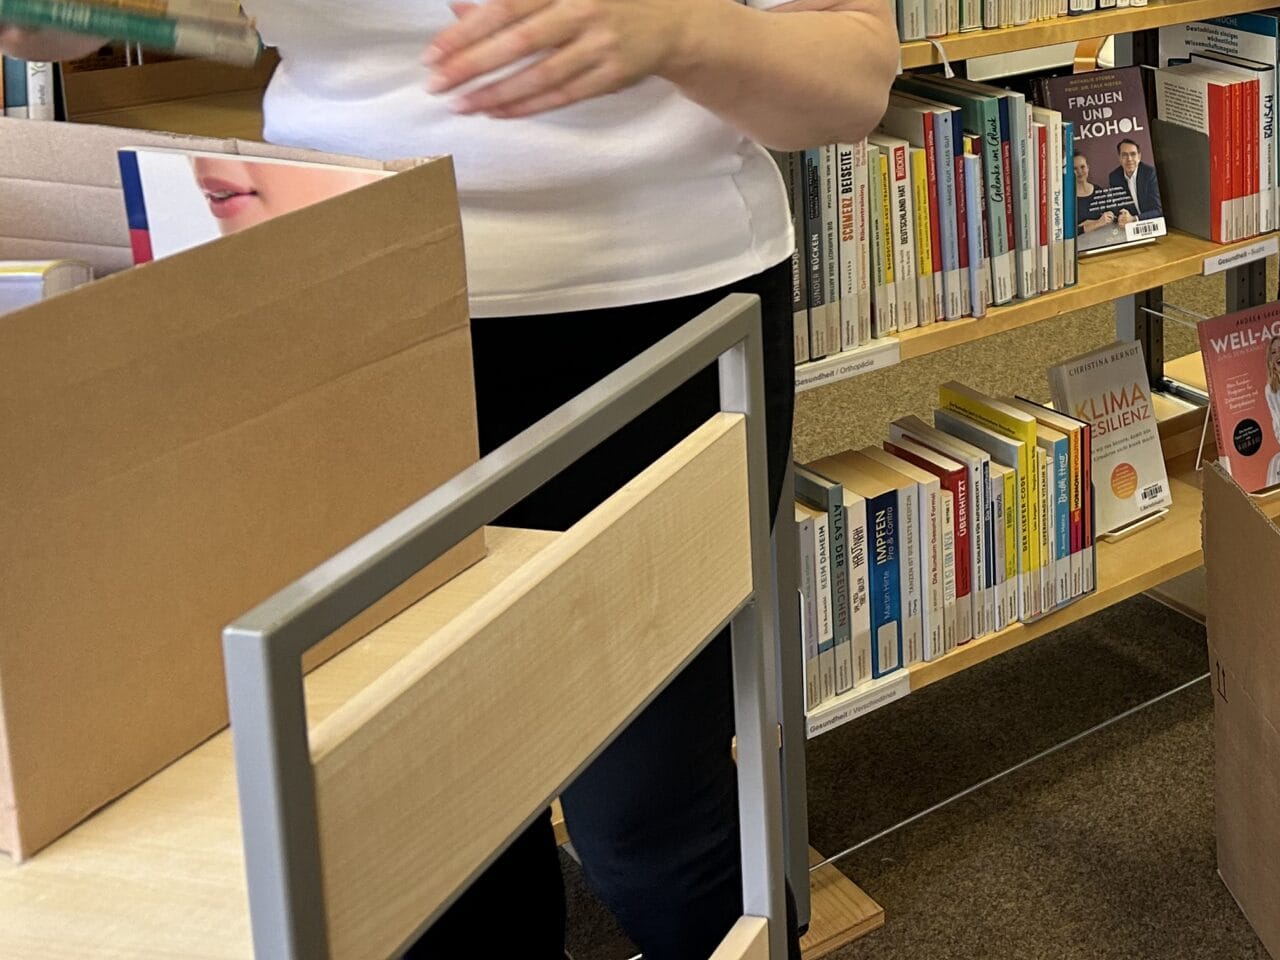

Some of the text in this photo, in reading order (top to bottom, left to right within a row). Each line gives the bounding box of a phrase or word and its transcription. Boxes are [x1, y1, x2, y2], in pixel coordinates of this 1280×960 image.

[1185, 39, 1238, 55] Wissenschaftsmagazin
[1186, 25, 1220, 37] Deutschlands
[1068, 91, 1123, 110] FRAUEN
[1082, 107, 1113, 122] UND
[1264, 95, 1274, 140] RAUSCH
[987, 117, 1003, 203] Gelenke Glück
[840, 150, 854, 242] SCHMERZ BEISEITE
[899, 202, 909, 245] DEUTSCHLAND
[811, 233, 820, 270] RÜCKEN
[1218, 251, 1247, 266] Gesundheit
[795, 370, 835, 386] Gesundheit
[1069, 346, 1140, 377] CHRISTINA BERNDT
[1075, 382, 1148, 422] KLIMA
[1091, 405, 1151, 440] ESILIENZ
[886, 507, 894, 535] Contra
[957, 479, 967, 537] ÜBERHITZT
[818, 525, 827, 563] DAHEIM
[875, 509, 887, 566] IMPFEN
[833, 504, 847, 628] ATLAS DER SEUCHEN
[810, 711, 849, 733] Gesundheit
